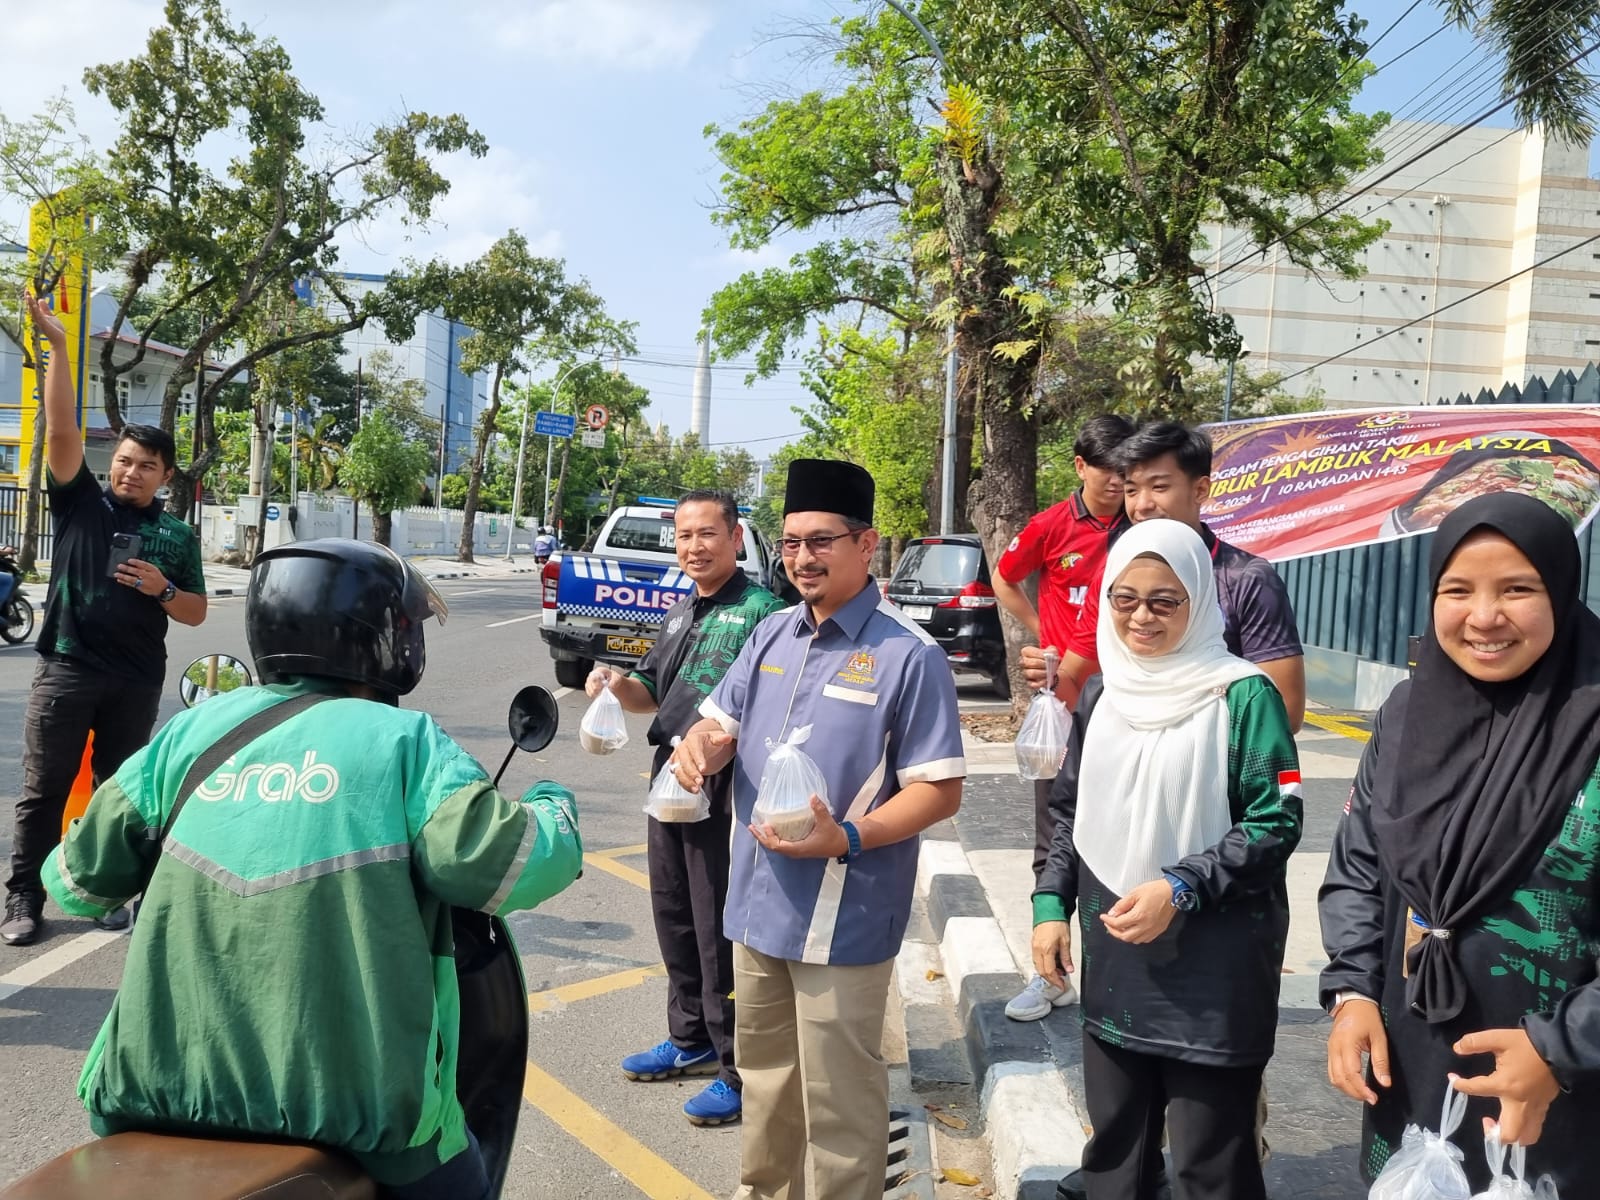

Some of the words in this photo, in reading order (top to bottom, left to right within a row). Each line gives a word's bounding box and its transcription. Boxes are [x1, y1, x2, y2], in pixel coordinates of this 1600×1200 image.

[1210, 461, 1259, 482] OGRAM
[1258, 441, 1363, 470] PENGAGIHAN
[1261, 448, 1379, 486] LAMBUK
[1379, 435, 1552, 463] MALAYSIA
[1223, 494, 1253, 507] 2024
[1278, 483, 1295, 496] 10
[1294, 469, 1375, 492] RAMADAN
[1374, 463, 1409, 478] 1445
[194, 750, 340, 804] Grab
